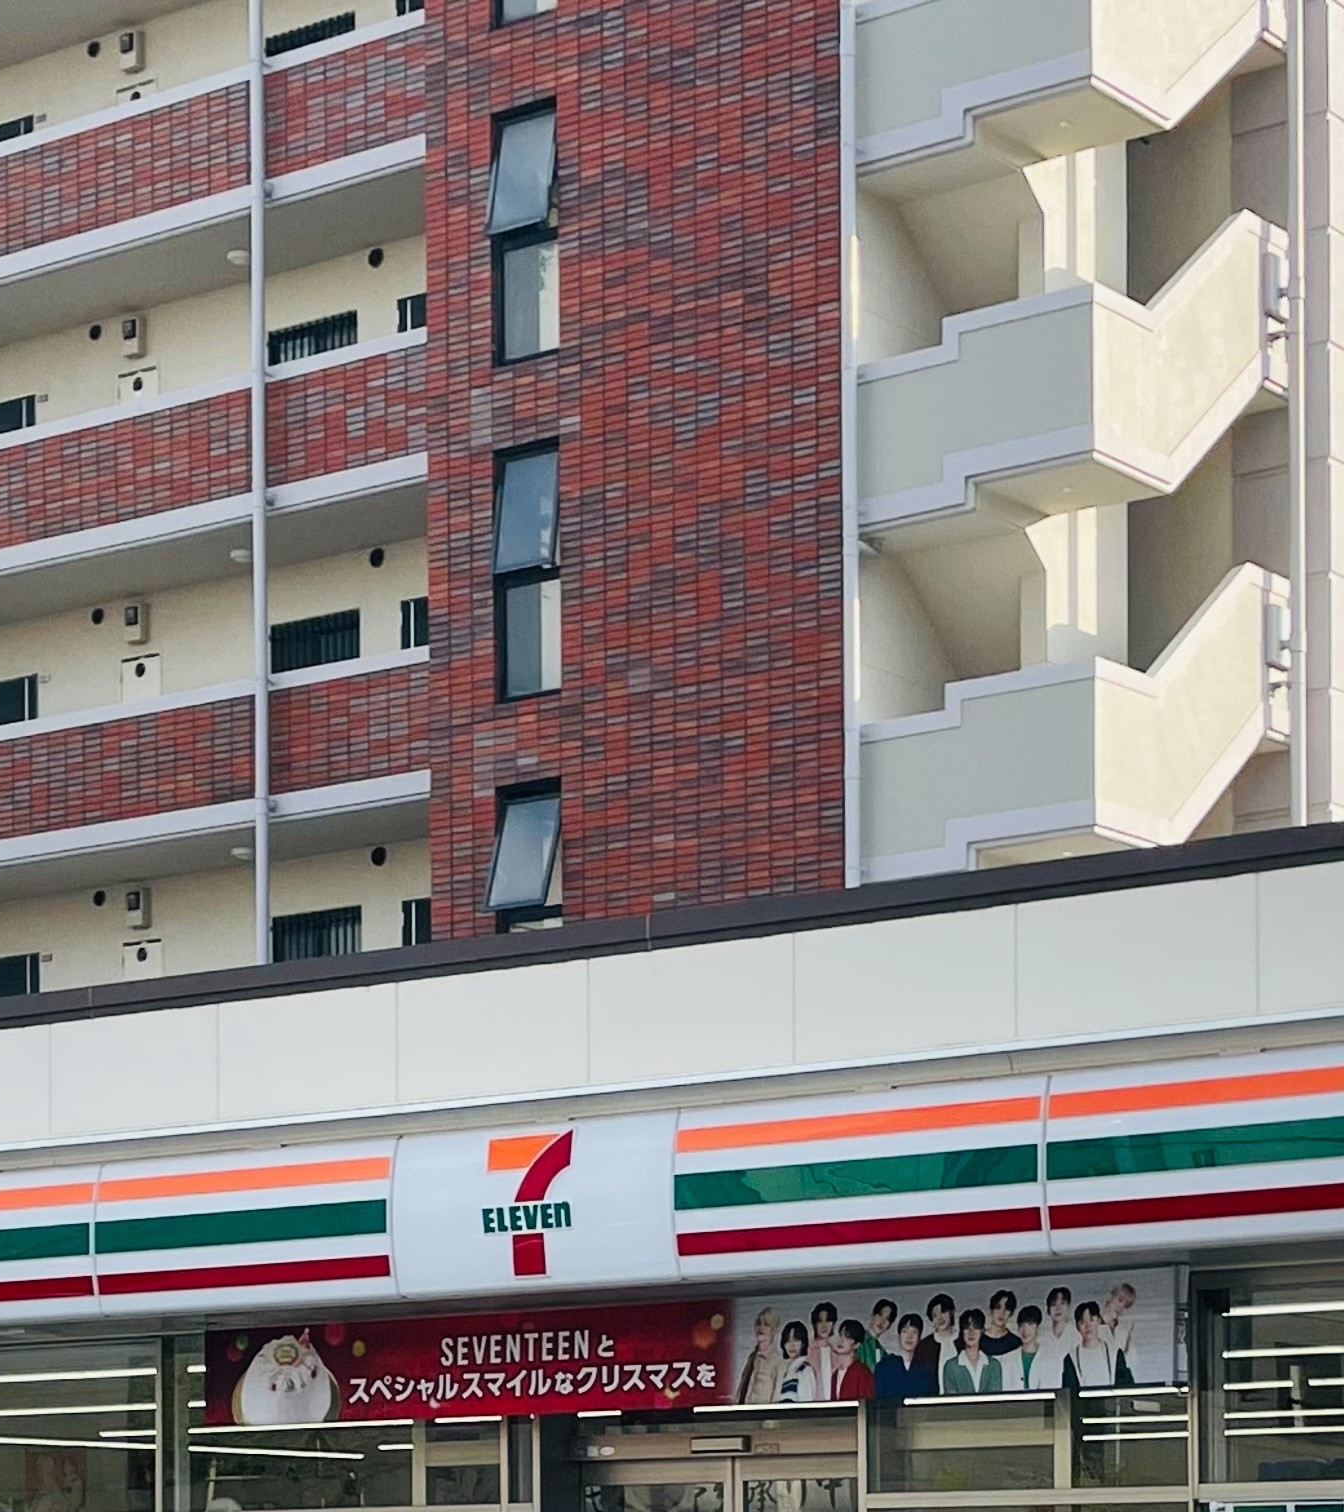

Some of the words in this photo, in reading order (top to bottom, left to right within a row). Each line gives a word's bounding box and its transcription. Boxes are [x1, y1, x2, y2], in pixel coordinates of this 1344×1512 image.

[488, 1130, 574, 1276] 7
[440, 1330, 590, 1367] SEVENTEEN
[348, 1361, 716, 1404] スペシャルスマイルなクリスマスを
